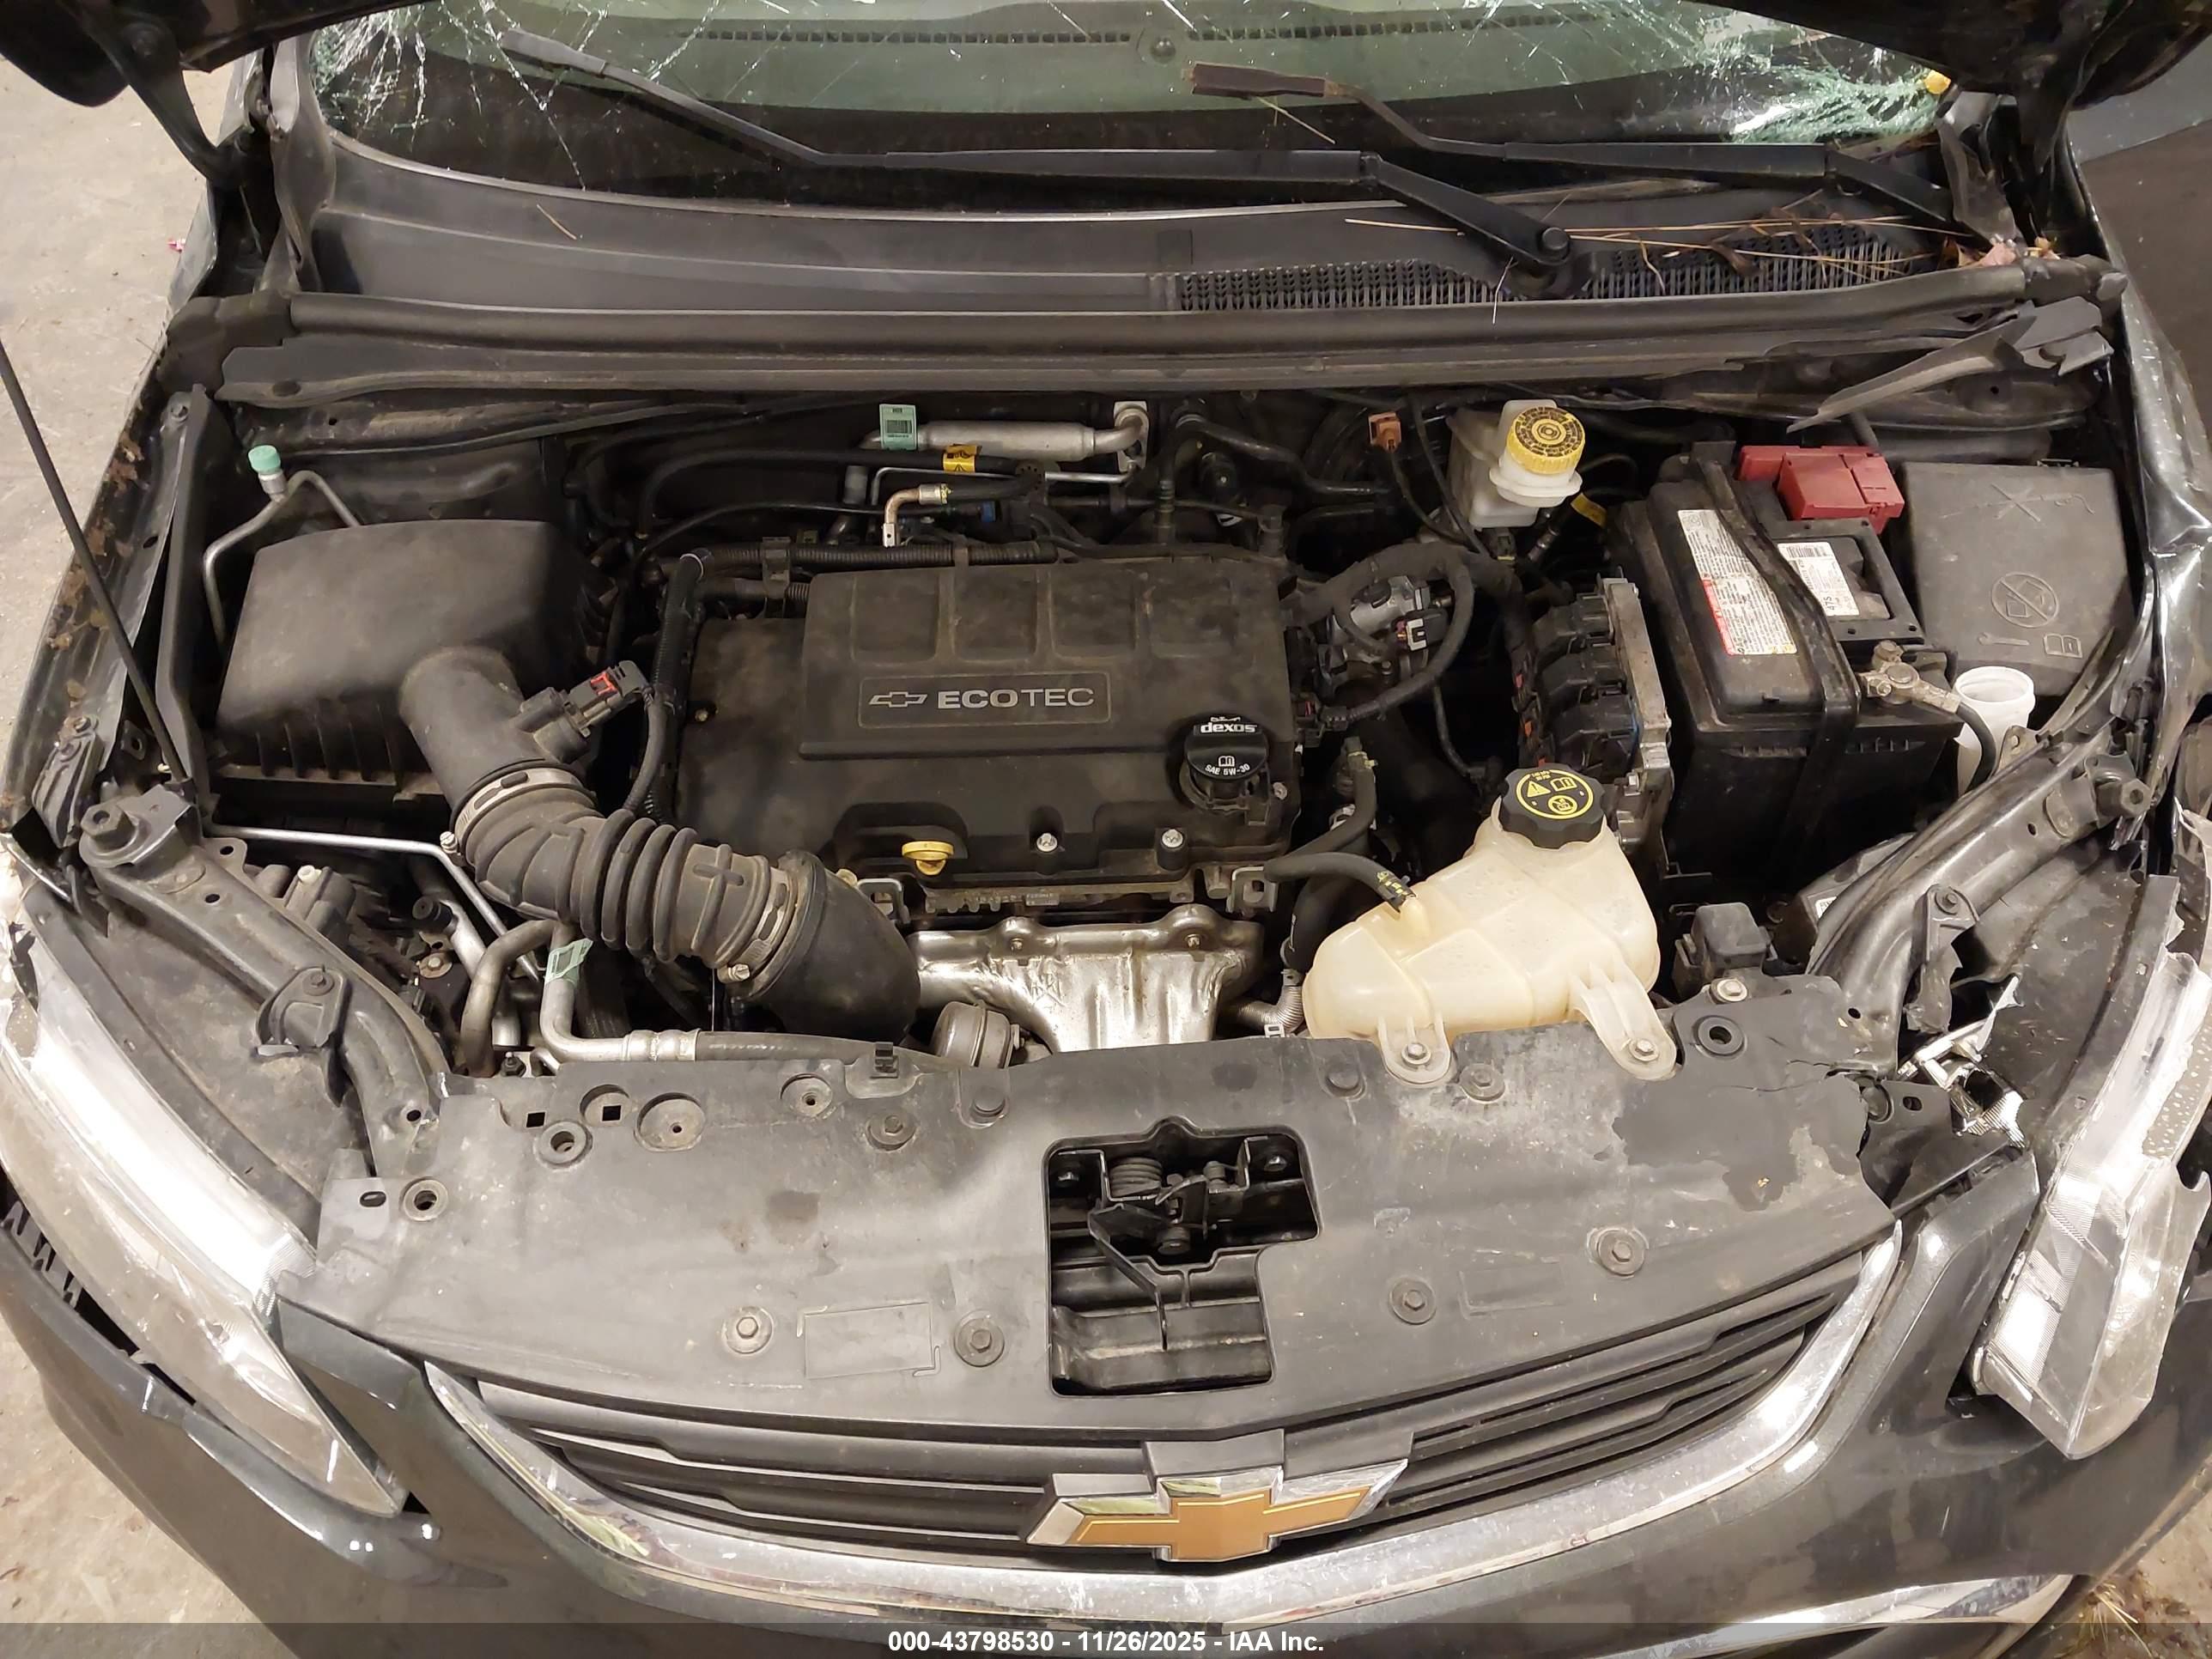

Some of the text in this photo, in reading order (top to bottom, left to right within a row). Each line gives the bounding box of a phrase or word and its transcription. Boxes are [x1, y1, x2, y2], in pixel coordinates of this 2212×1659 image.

[937, 688, 1094, 709] ECOTEC
[1200, 722, 1258, 733] dexos
[1206, 764, 1250, 776] SAE 5W-30
